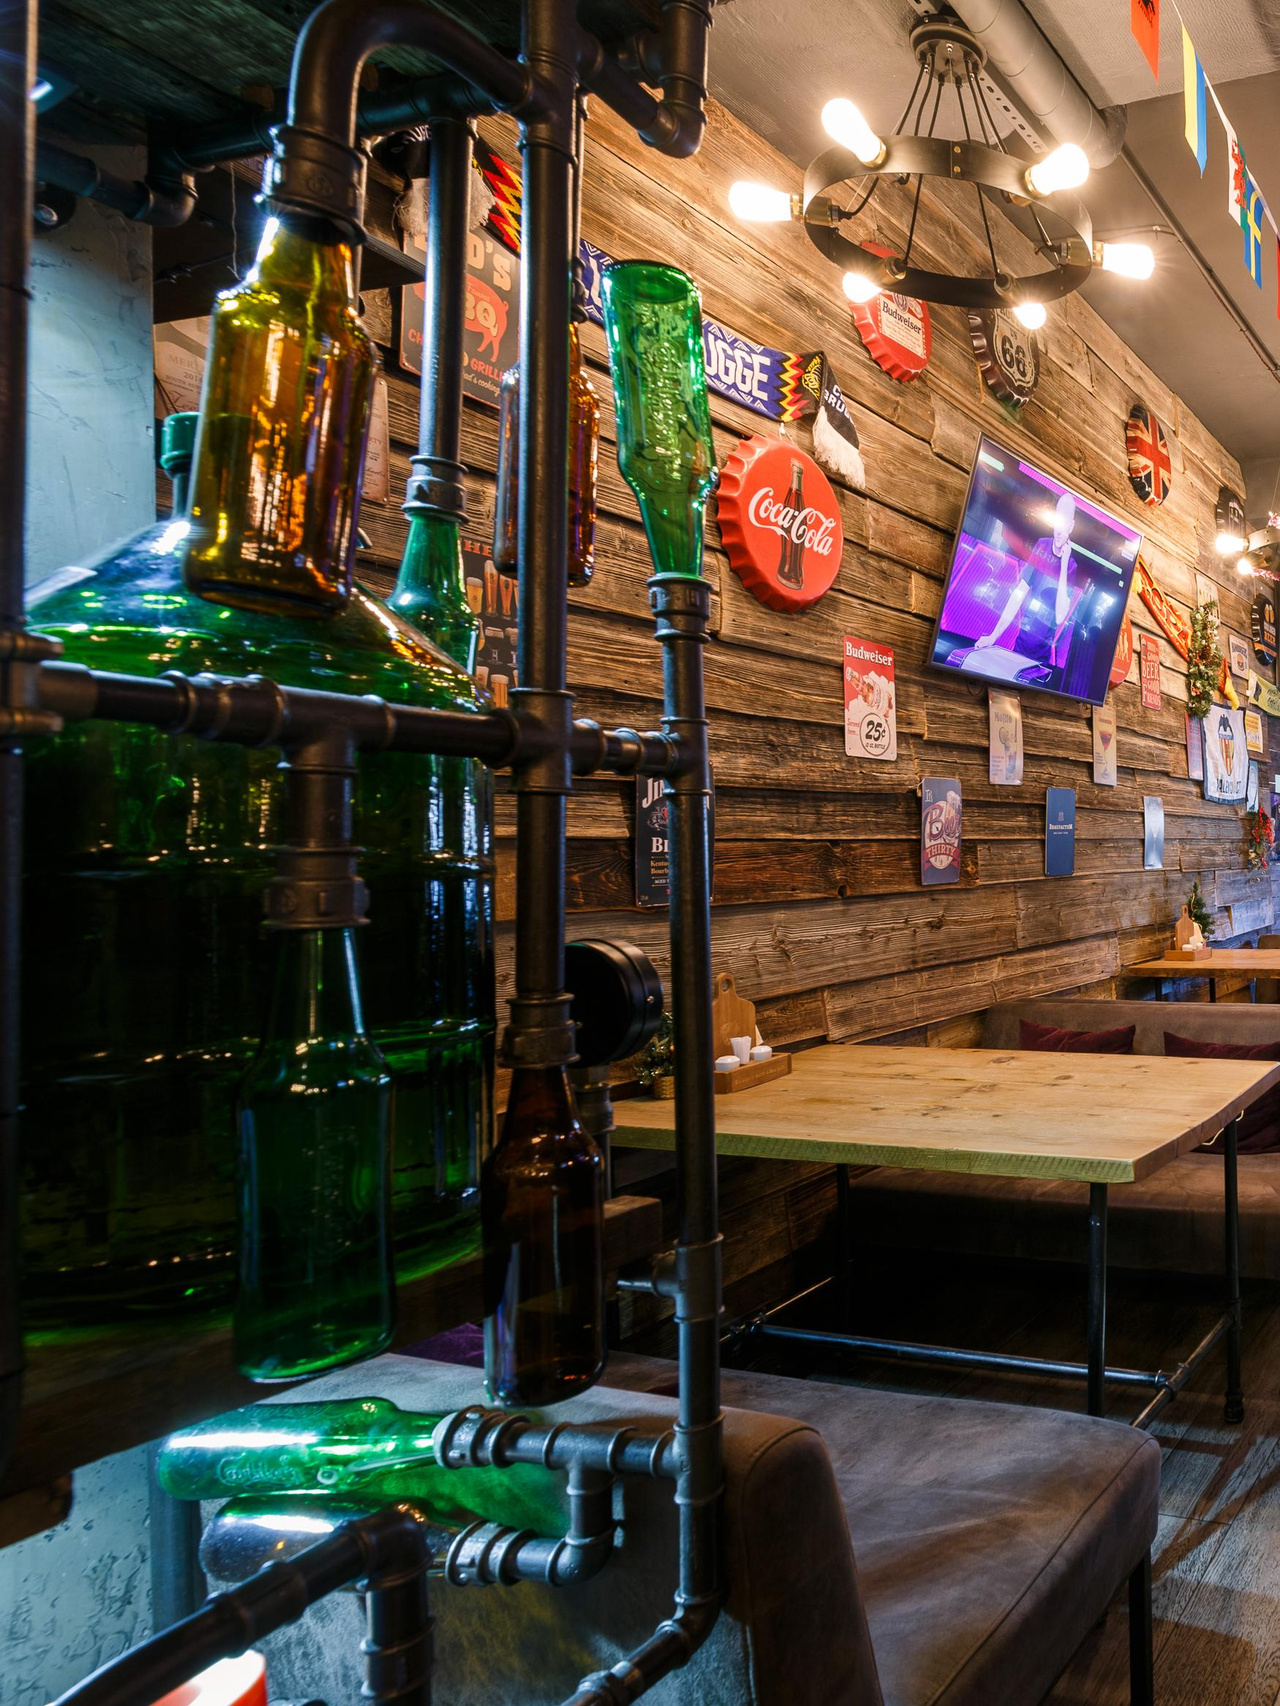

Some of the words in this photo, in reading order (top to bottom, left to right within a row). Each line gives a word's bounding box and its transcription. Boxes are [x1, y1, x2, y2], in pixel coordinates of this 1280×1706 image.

[465, 296, 498, 337] BQ
[882, 301, 922, 334] Budweiser
[702, 333, 771, 401] UGGE
[1001, 334, 1027, 379] 66
[748, 487, 836, 556] Coca-Cola
[845, 641, 893, 667] Budweiser
[1142, 659, 1160, 681] BEER
[925, 844, 956, 858] THIRTY
[650, 867, 669, 875] Bourb
